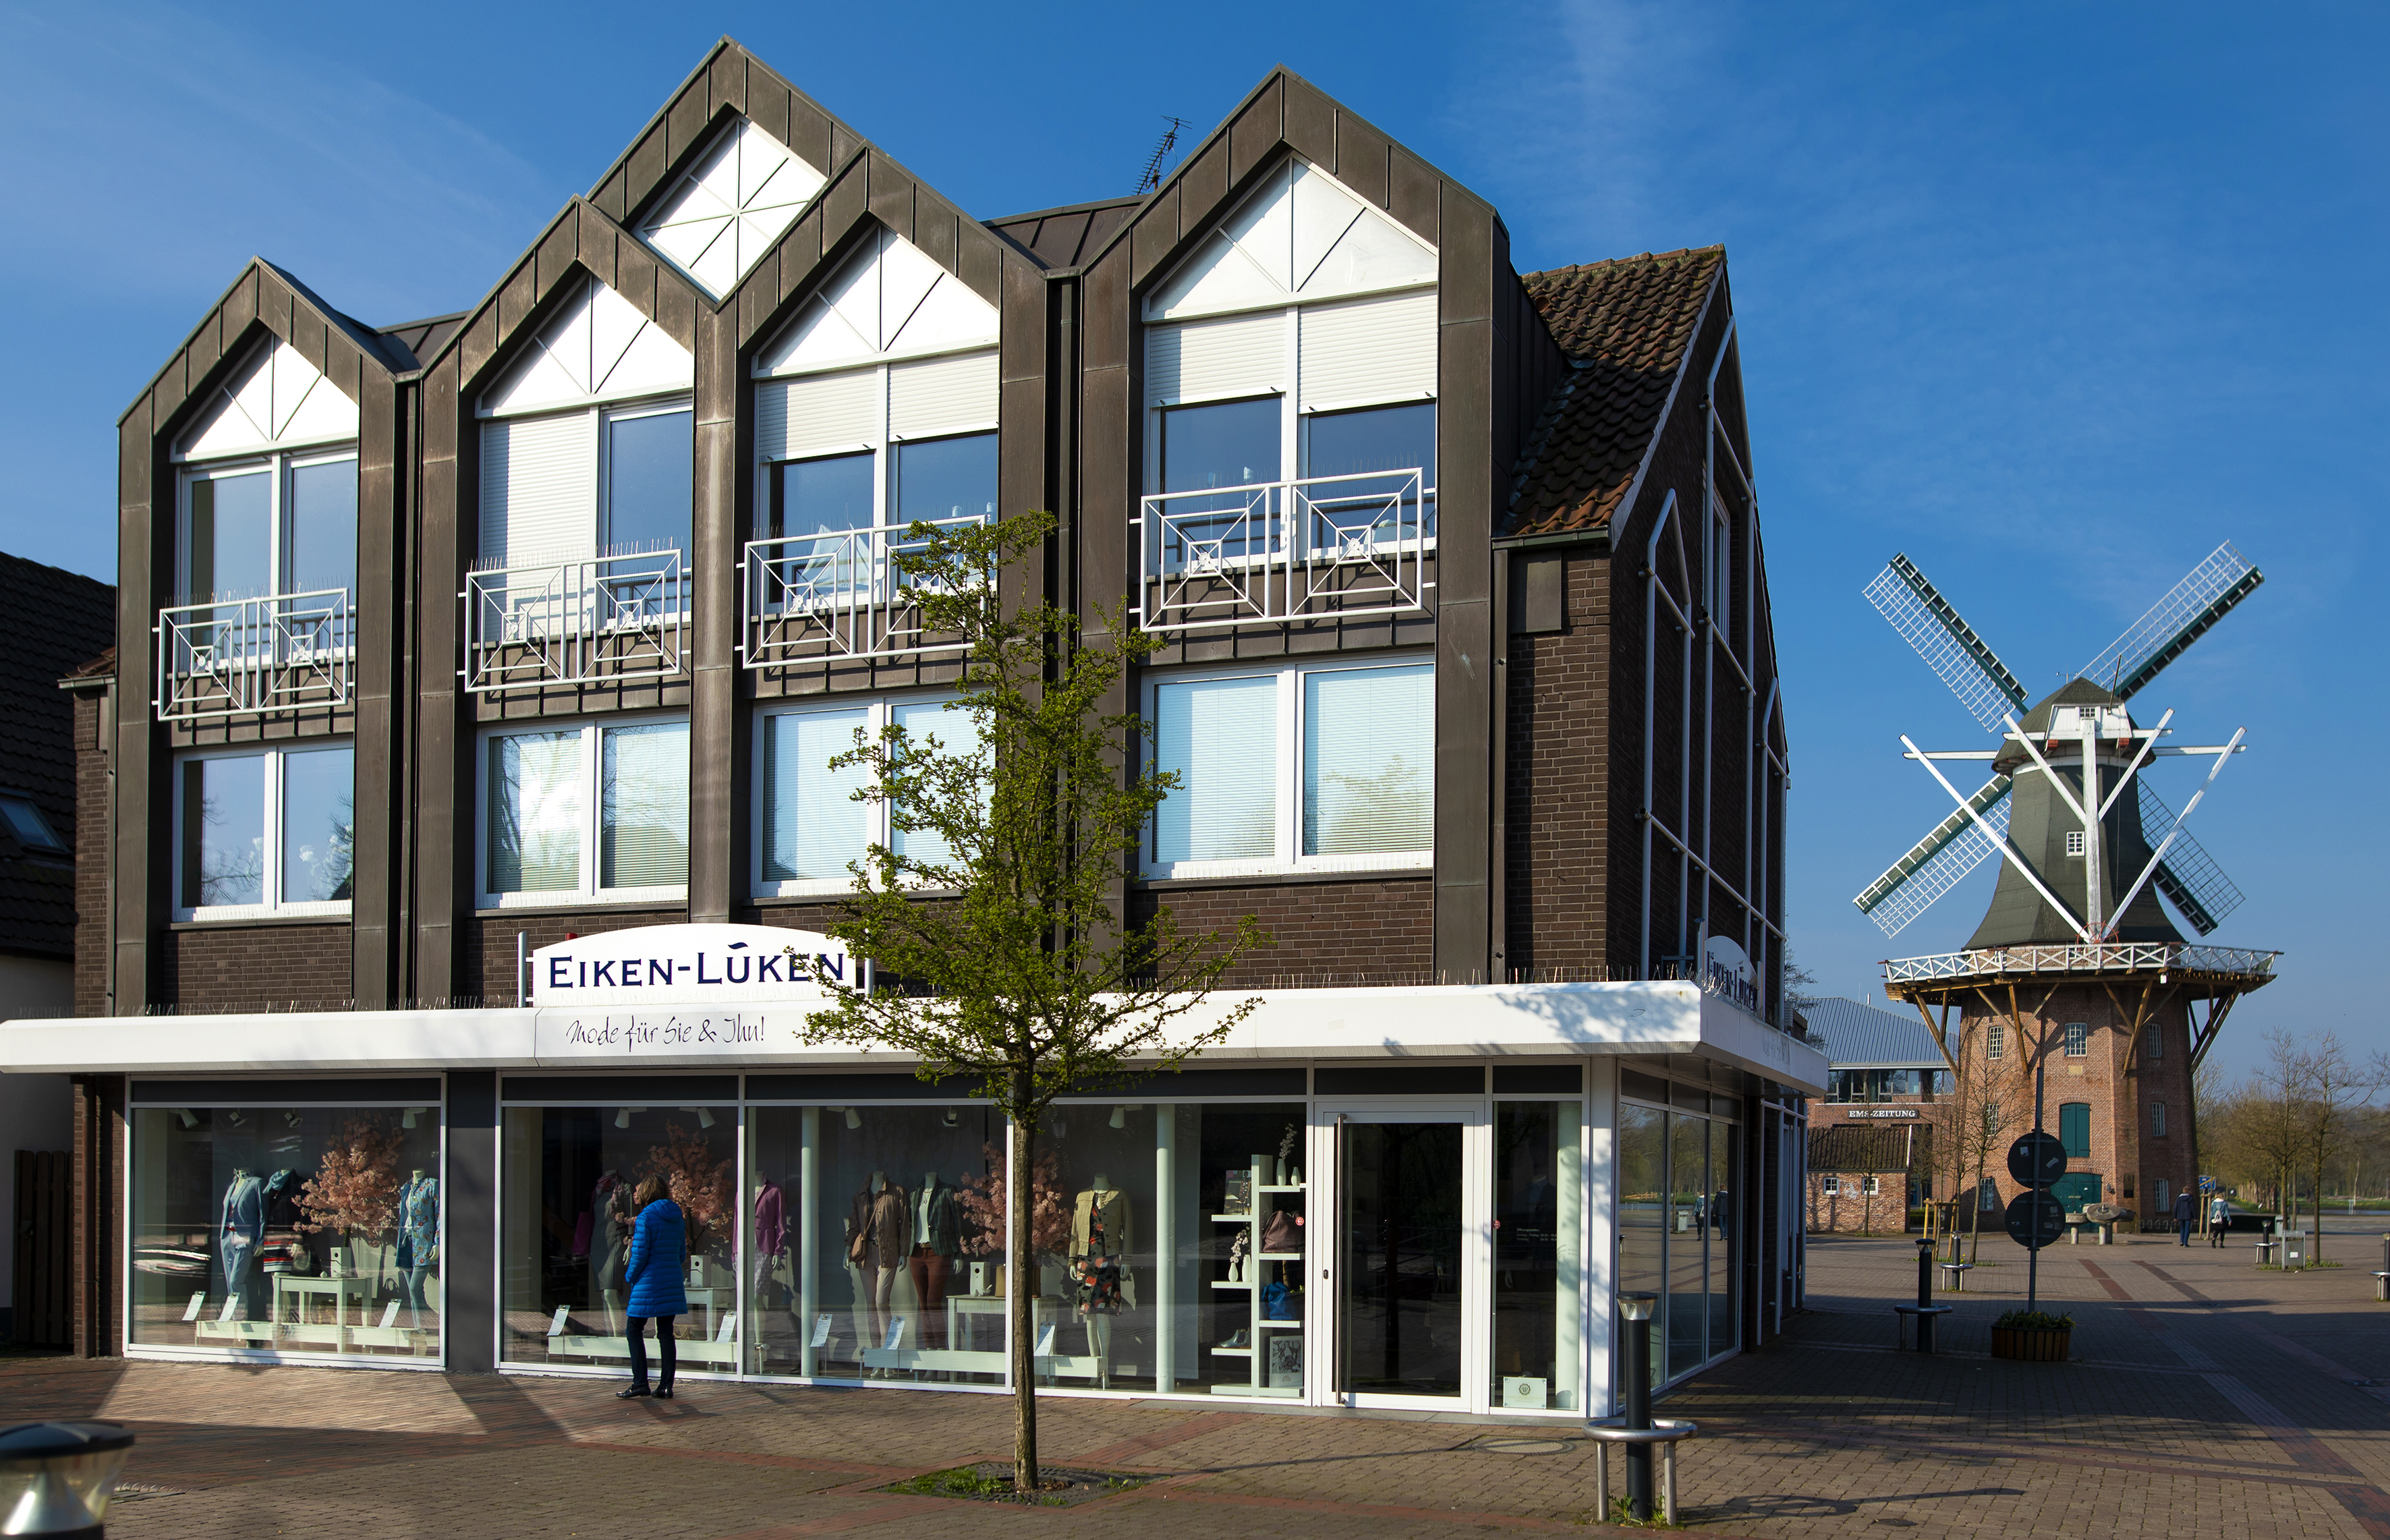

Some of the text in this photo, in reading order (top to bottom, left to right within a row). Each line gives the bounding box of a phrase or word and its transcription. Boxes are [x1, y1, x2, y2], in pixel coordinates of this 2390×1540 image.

[566, 1013, 764, 1052] Mode für Sie & Ihn!
